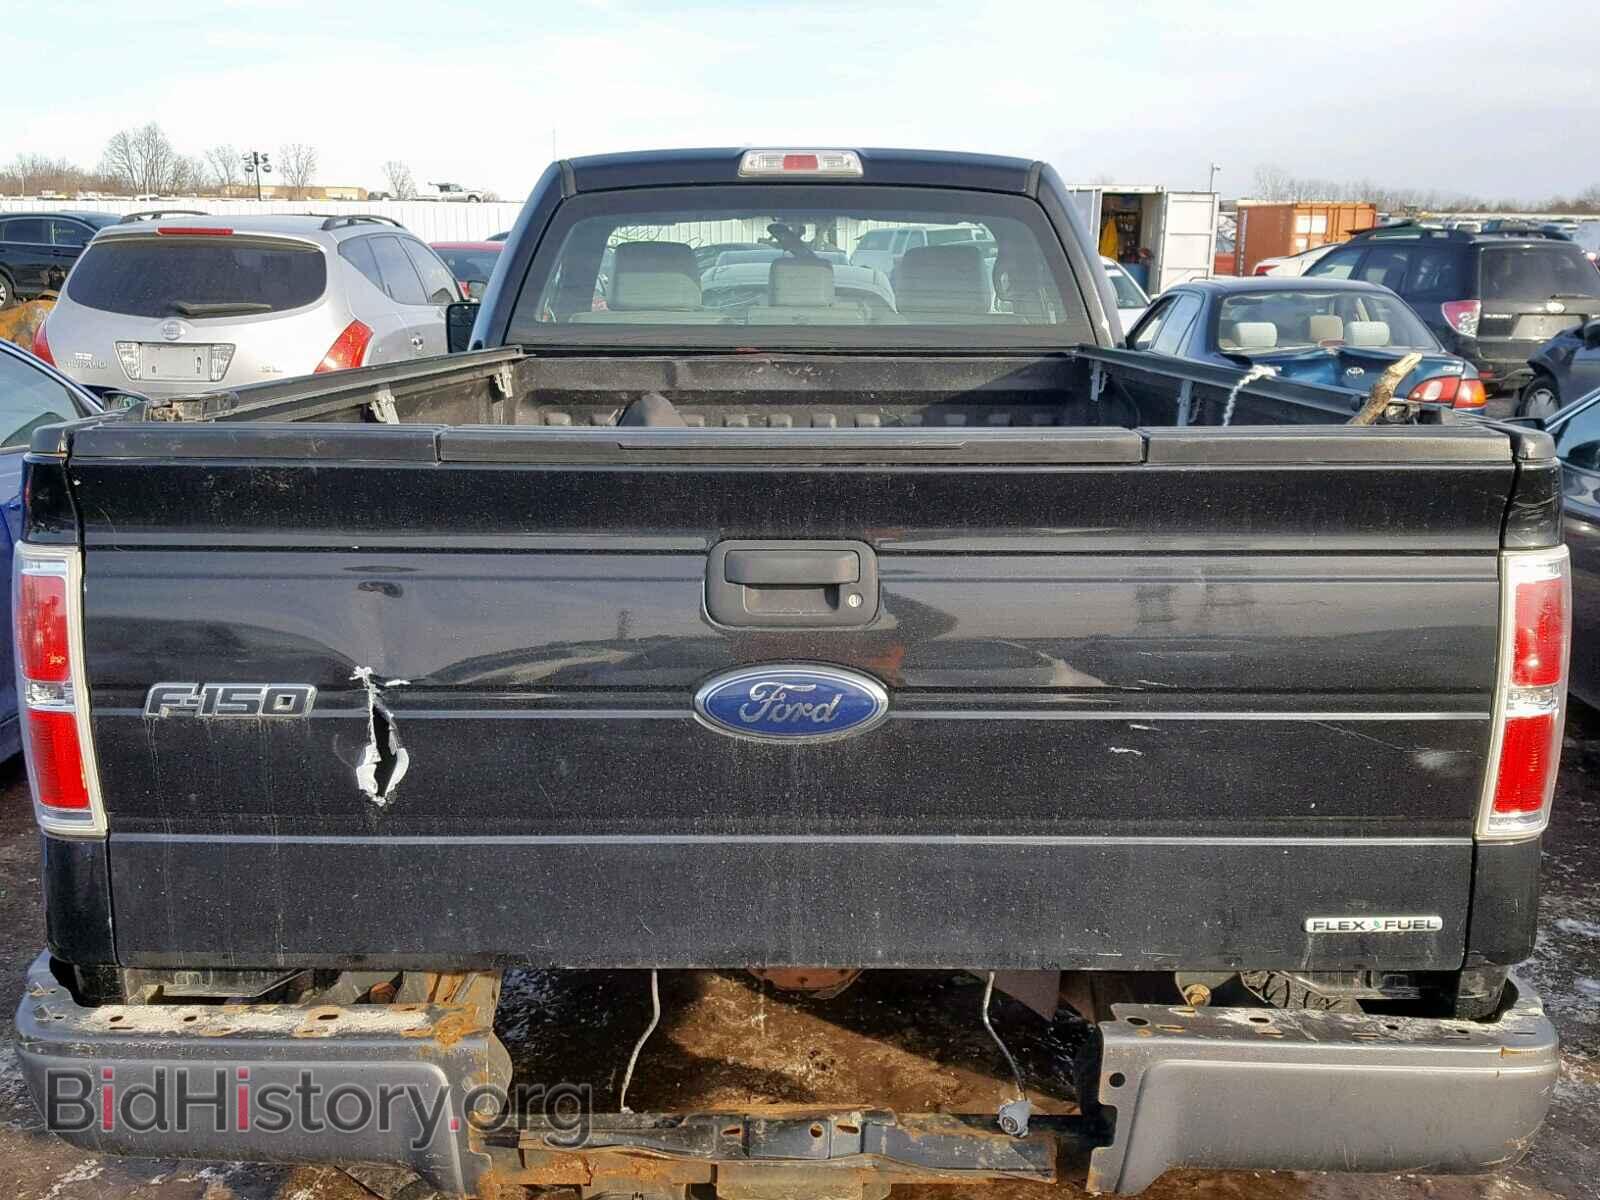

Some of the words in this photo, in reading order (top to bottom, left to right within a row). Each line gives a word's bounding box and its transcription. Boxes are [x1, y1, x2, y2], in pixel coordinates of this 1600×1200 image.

[143, 682, 318, 719] F-150
[739, 681, 842, 723] Ford
[1313, 920, 1366, 931] FLEX
[1384, 919, 1439, 931] FUEL
